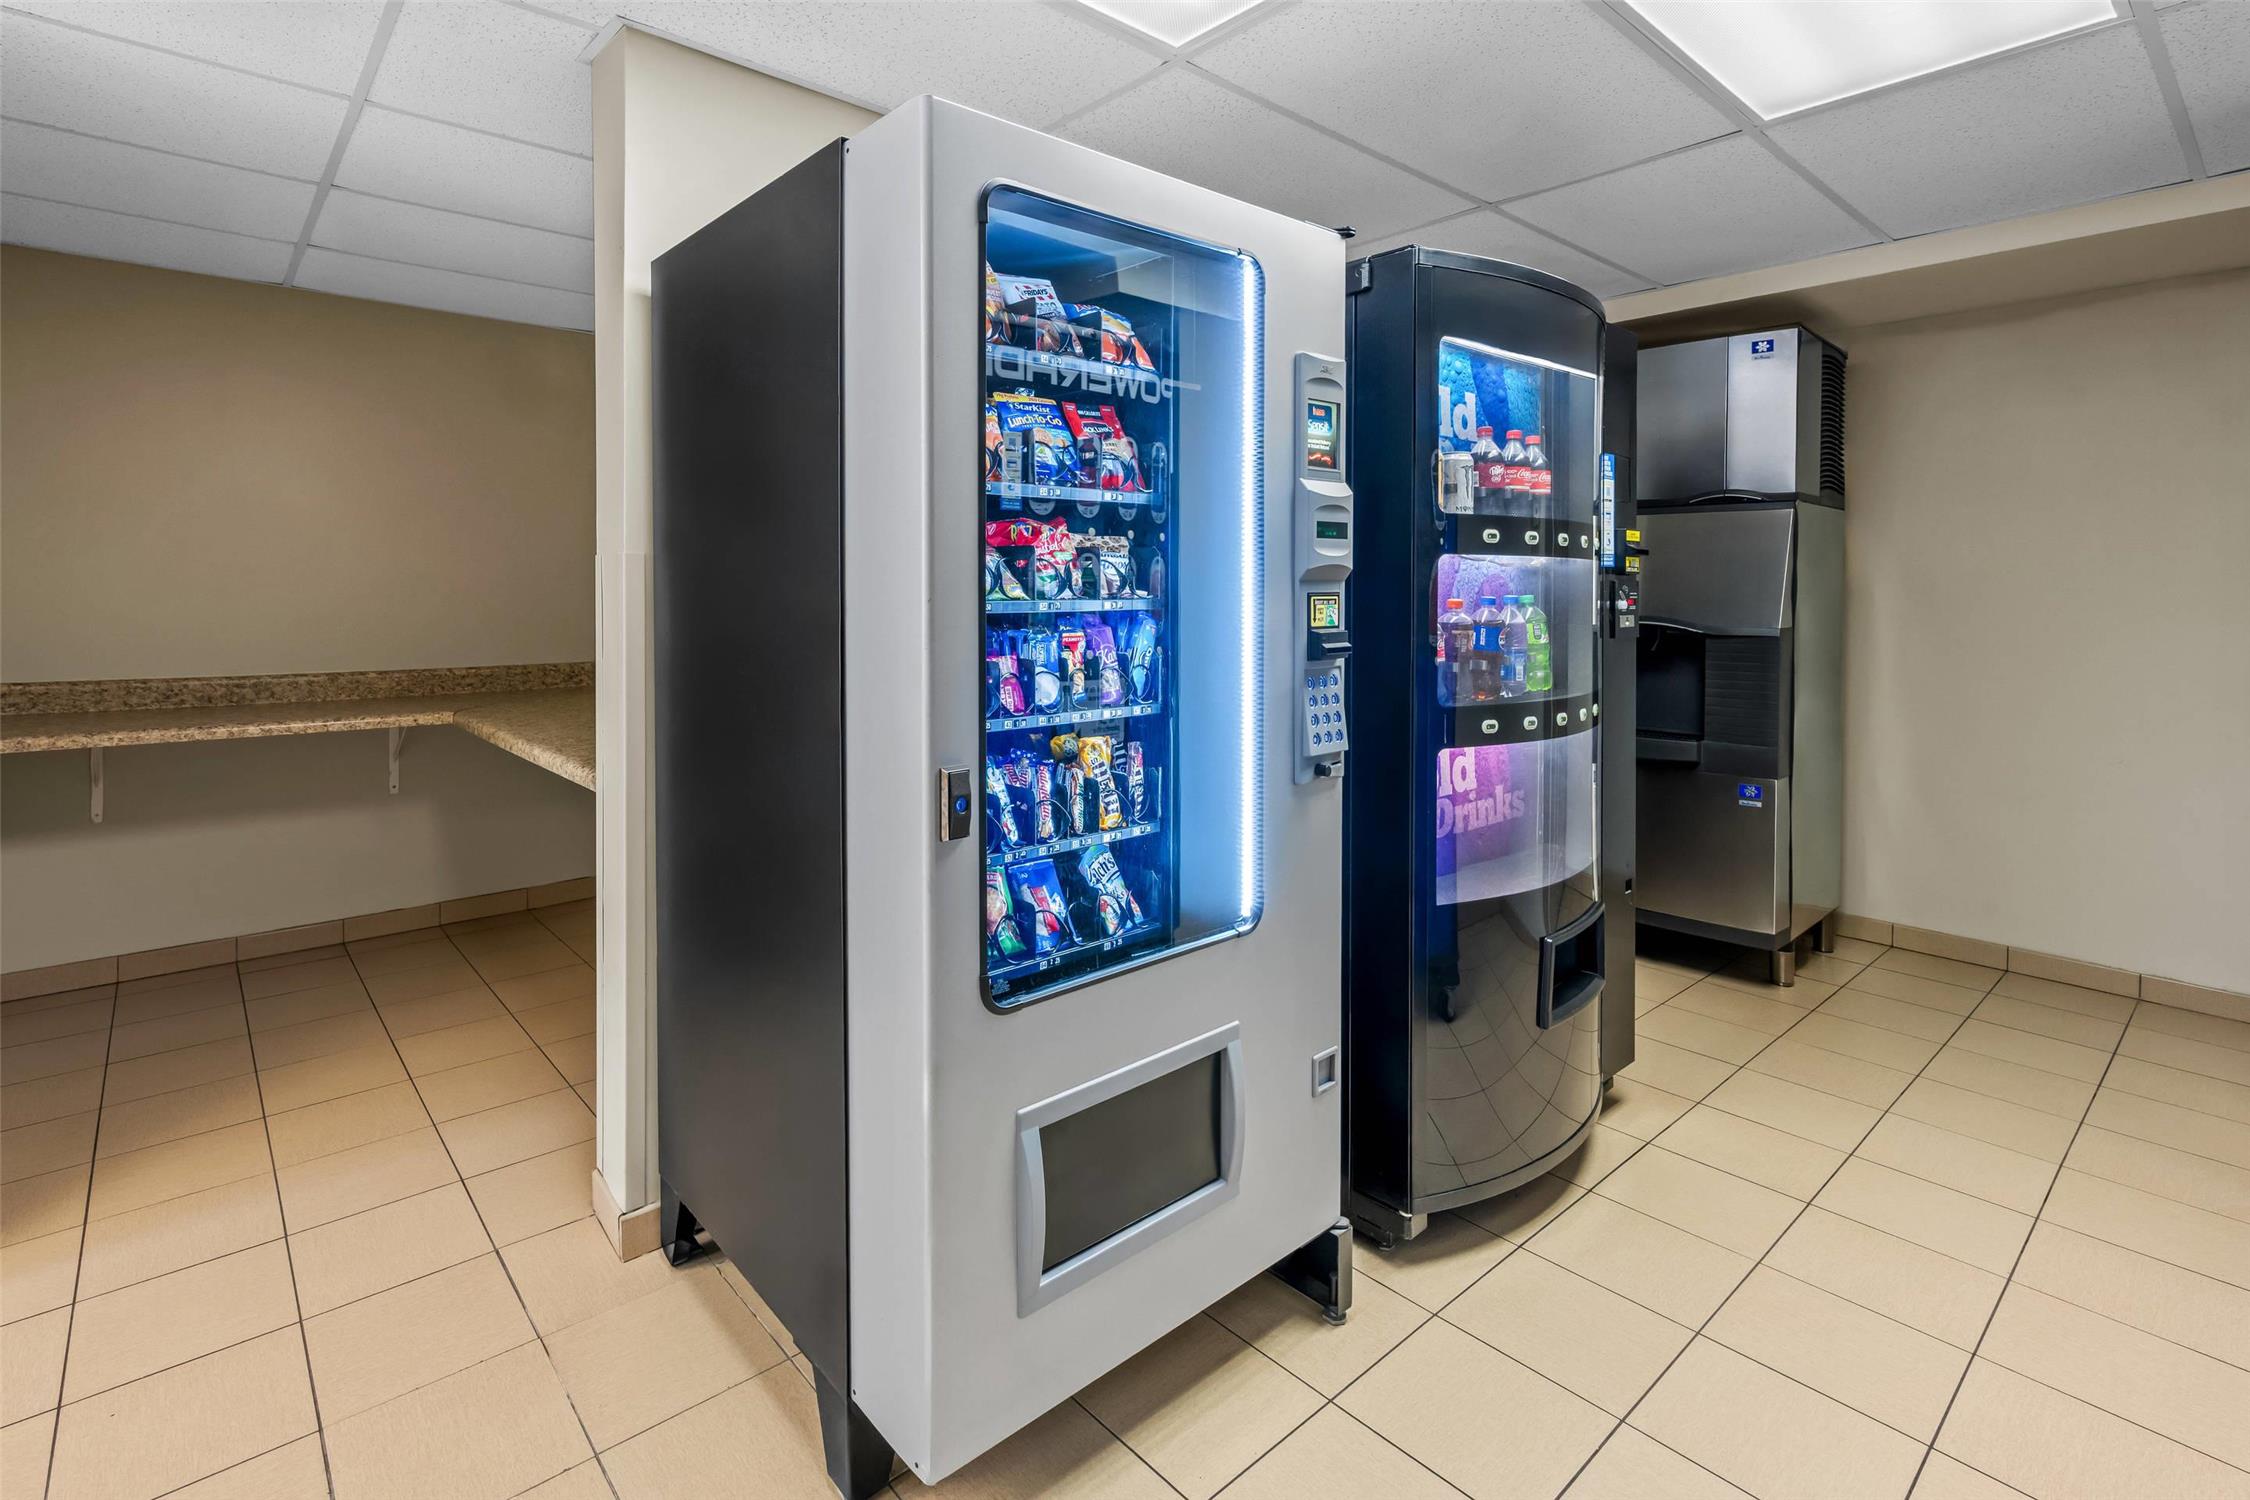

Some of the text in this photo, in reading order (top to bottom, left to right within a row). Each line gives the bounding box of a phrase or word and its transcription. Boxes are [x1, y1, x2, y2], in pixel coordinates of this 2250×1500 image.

[1023, 288, 1048, 297] FRIDAYS
[1014, 402, 1051, 414] StarKist
[1007, 414, 1063, 428] Lunch-To-Go
